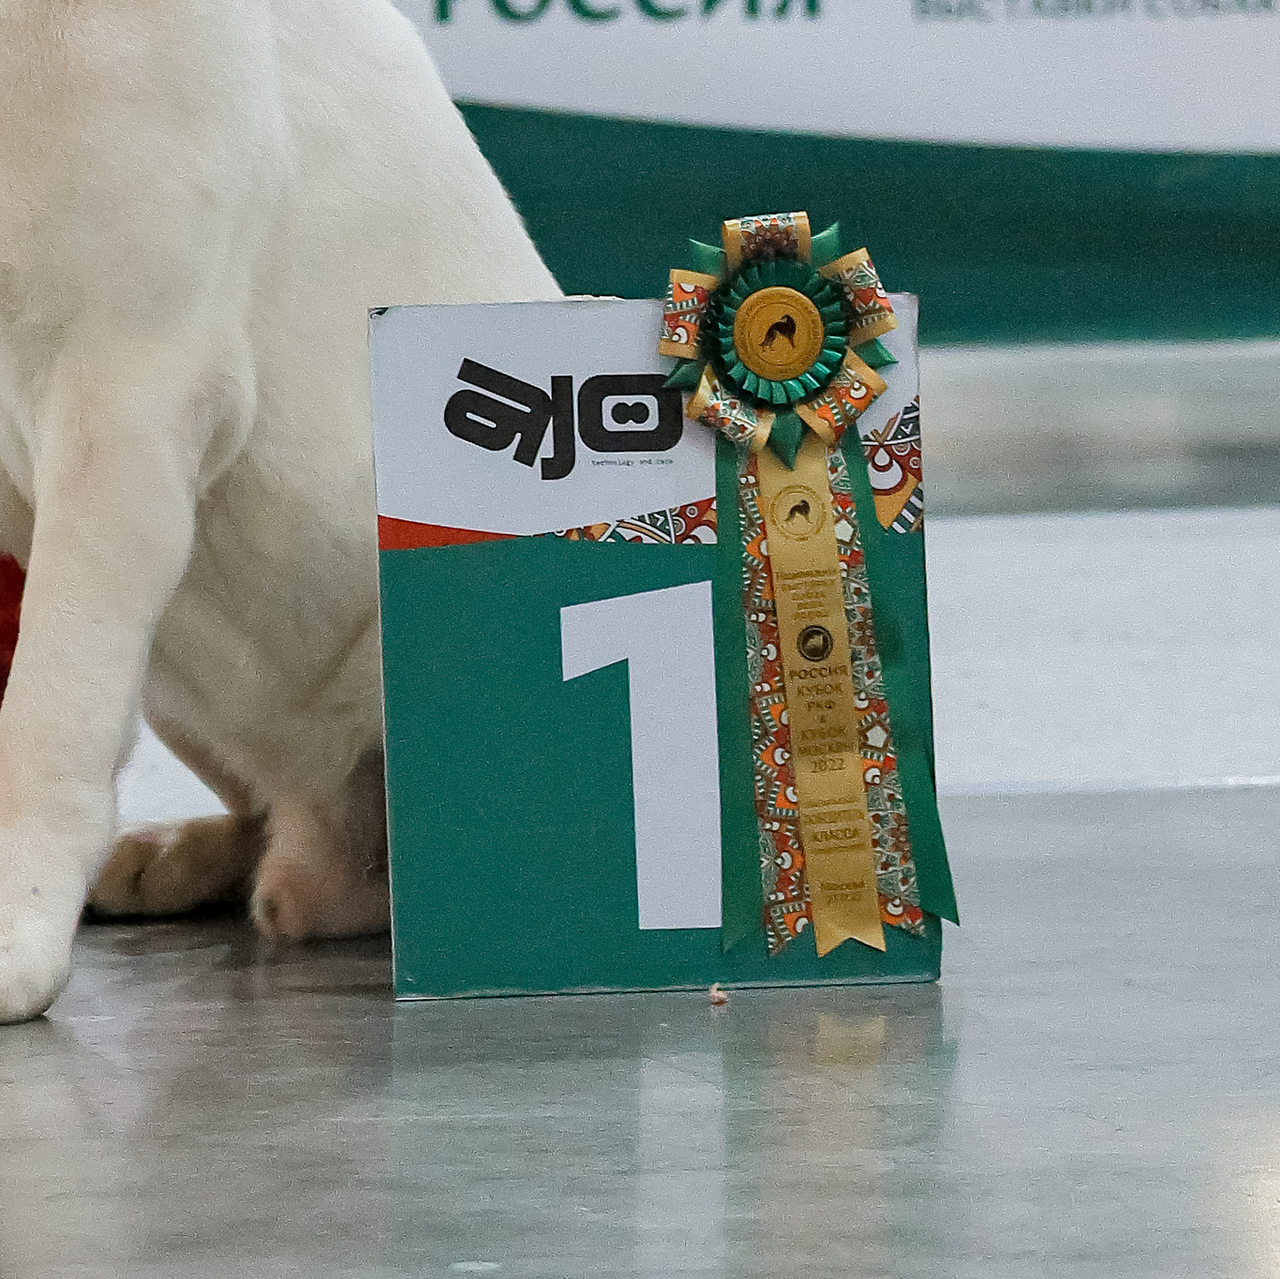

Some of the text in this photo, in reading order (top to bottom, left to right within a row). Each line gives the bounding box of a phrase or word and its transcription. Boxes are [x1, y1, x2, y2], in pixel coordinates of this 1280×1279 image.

[789, 664, 848, 680] РОССИЯ
[797, 683, 843, 697] КУБОК
[560, 580, 722, 930] 1
[810, 758, 847, 773] 2022
